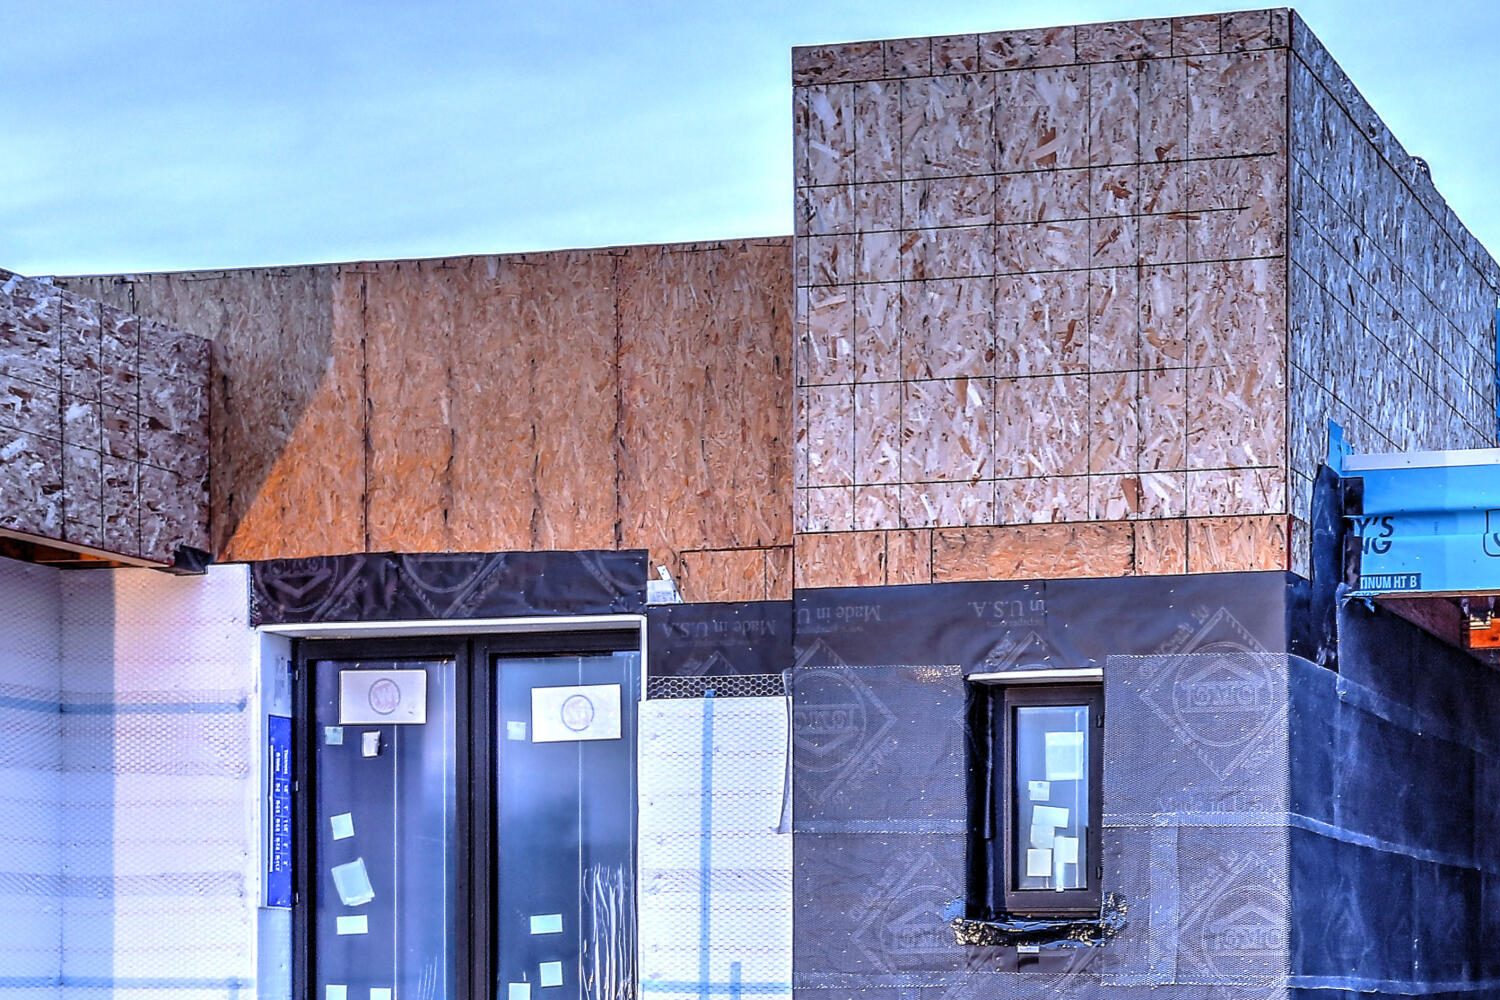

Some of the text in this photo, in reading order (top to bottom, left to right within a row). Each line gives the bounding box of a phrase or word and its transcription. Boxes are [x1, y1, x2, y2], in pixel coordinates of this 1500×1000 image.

[1360, 575, 1417, 589] TINUM HT B
[837, 605, 881, 622] Made
[734, 619, 776, 636] Made
